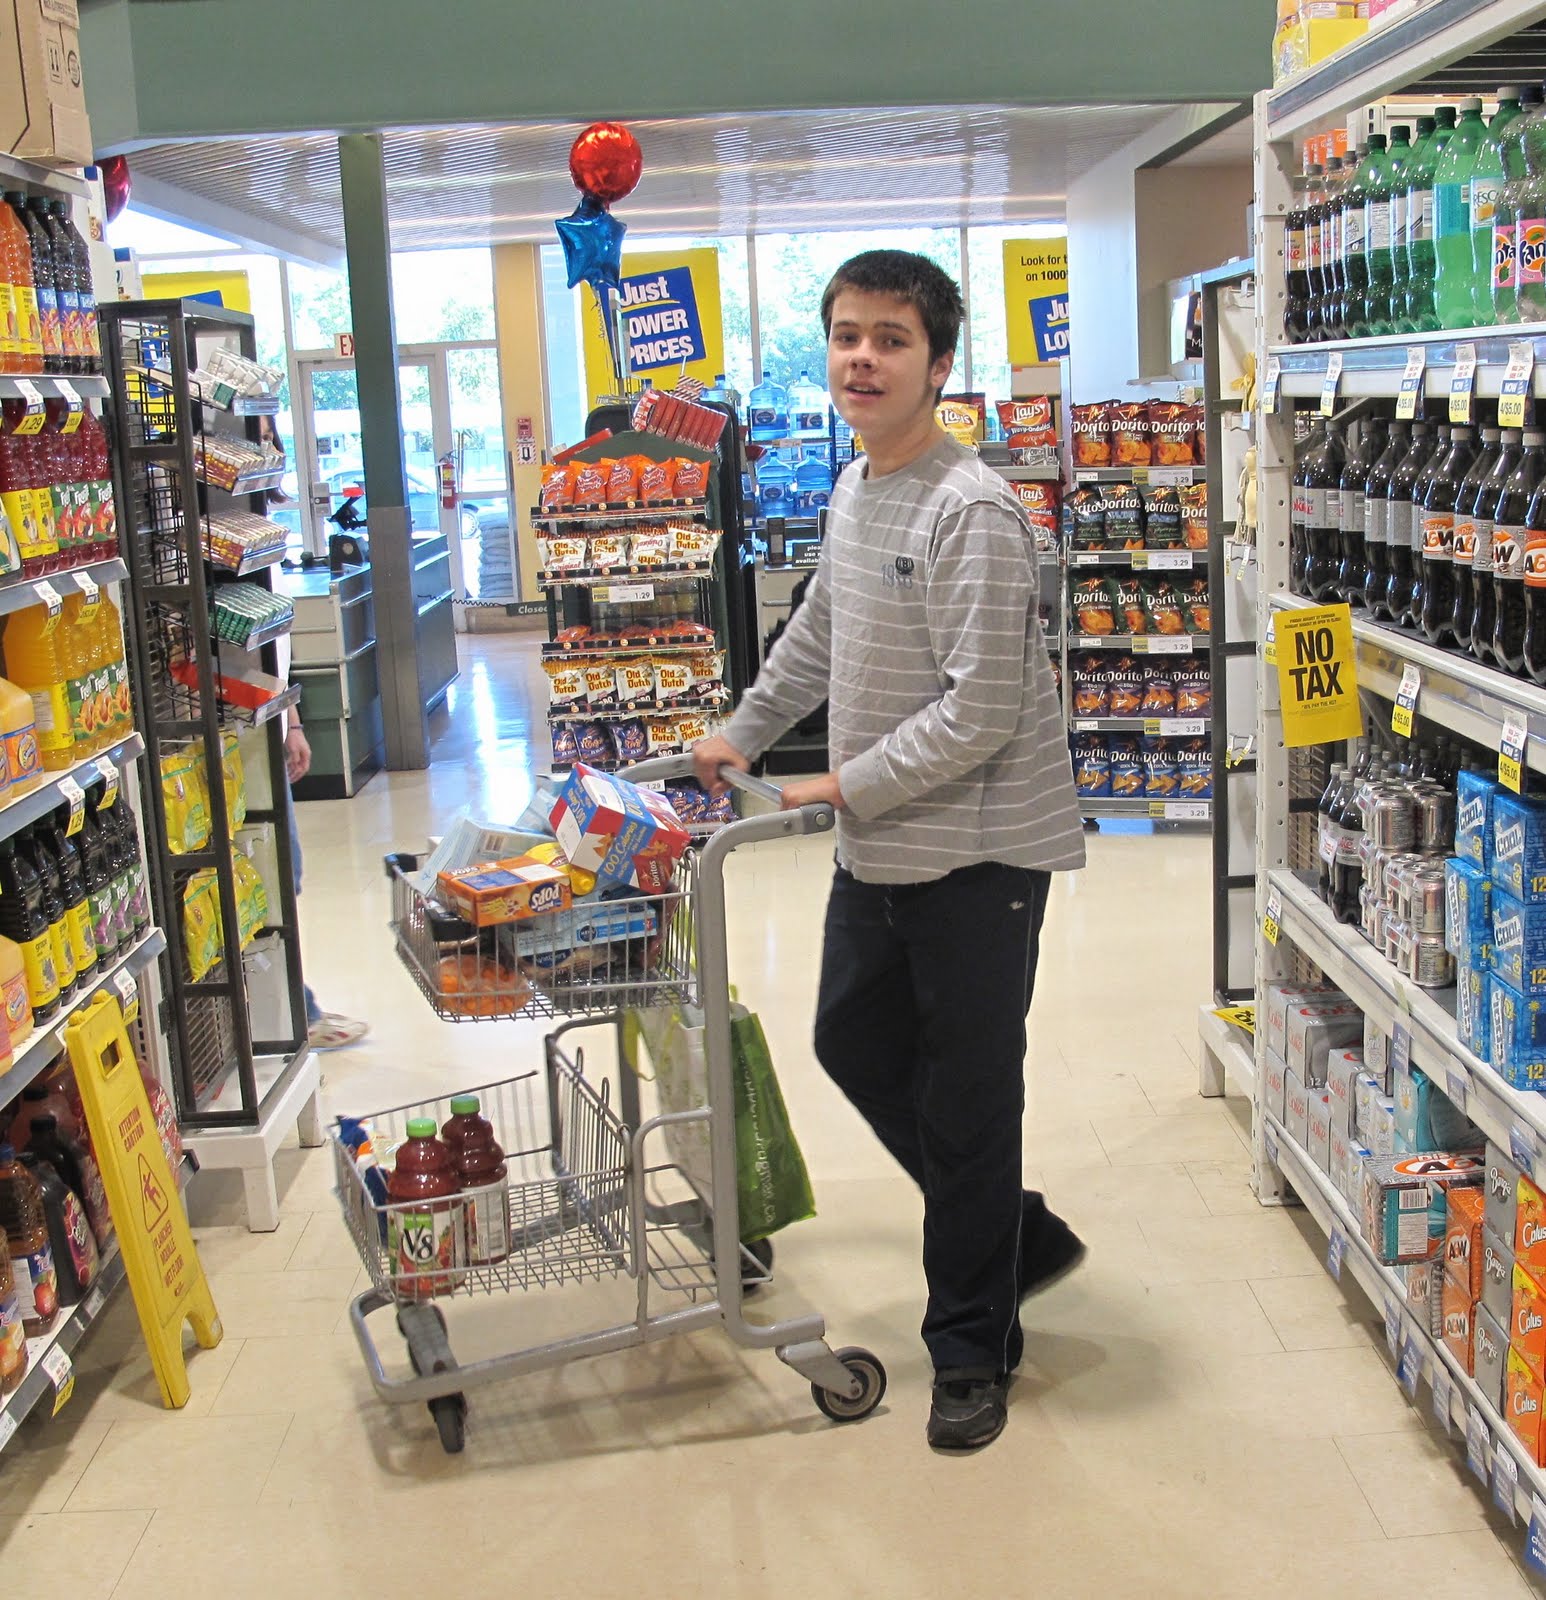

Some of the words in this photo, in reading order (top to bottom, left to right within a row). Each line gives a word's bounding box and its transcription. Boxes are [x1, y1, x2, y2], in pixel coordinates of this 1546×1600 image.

[1021, 255, 1044, 266] Look
[1047, 255, 1061, 265] for
[1026, 272, 1038, 281] on
[619, 276, 669, 307] Just
[1044, 330, 1070, 351] LO
[1453, 383, 1463, 392] NOW
[1504, 383, 1517, 393] NOW
[1450, 399, 1467, 412] 4/$5.00
[1500, 402, 1521, 416] 4/$5.00
[22, 417, 42, 430] 1.29
[1174, 476, 1189, 484] 3.29
[676, 532, 691, 541] Old
[1173, 559, 1189, 567] 3.29
[634, 592, 651, 600] 1.29
[1174, 643, 1189, 651] 3.29
[1294, 627, 1334, 666] NO
[586, 671, 601, 682] Old
[626, 669, 640, 679] Old
[660, 669, 675, 679] Old
[553, 684, 577, 693] Dutch
[588, 680, 612, 690] Dutch
[627, 678, 651, 688] Dutch
[661, 678, 685, 688] Dutch
[697, 682, 712, 694] BBQ
[1397, 697, 1407, 706] NOW
[1393, 711, 1410, 728] 4/$5.00
[651, 726, 666, 734] Old
[679, 721, 693, 732] Old
[1186, 725, 1201, 733] 3.29
[652, 733, 676, 742] Dutch
[681, 728, 705, 742] Dutch
[1458, 802, 1483, 831] COOL
[1497, 829, 1522, 858] COOL
[604, 855, 620, 875] 100
[650, 860, 660, 887] Doritos
[1264, 920, 1277, 938] 2.99
[1495, 921, 1521, 945] COOL
[1527, 1063, 1545, 1080] 12
[1309, 1076, 1321, 1086] 12
[118, 1105, 141, 1139] ATTENTION
[123, 1121, 145, 1153] CAUTION
[1490, 1166, 1512, 1196] Barq's
[1522, 1222, 1546, 1248] Cplus
[403, 1225, 433, 1260] V8
[1449, 1235, 1467, 1259] A&W
[1485, 1247, 1506, 1278] Barq's
[1518, 1309, 1543, 1335] Cplus
[1478, 1327, 1498, 1359] Barq's
[1513, 1391, 1537, 1416] Cplus
